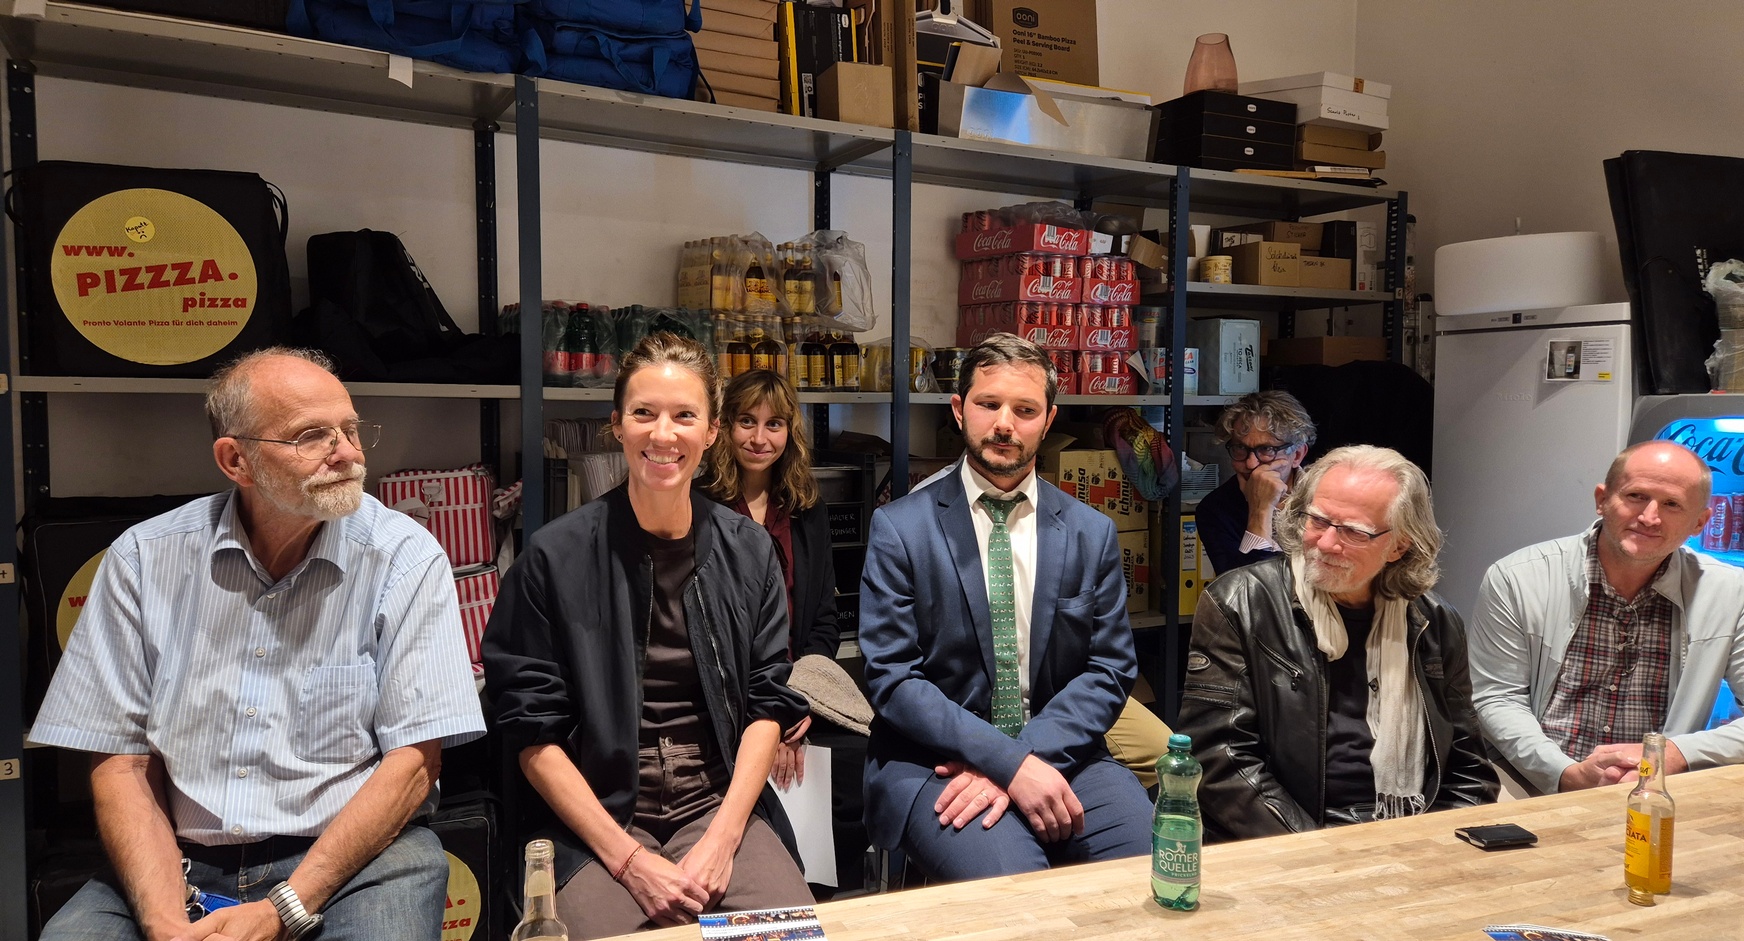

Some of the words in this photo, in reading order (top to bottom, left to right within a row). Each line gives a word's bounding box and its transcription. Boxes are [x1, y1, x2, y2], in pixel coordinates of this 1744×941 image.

[1016, 12, 1035, 22] ooni
[1012, 29, 1026, 37] Ooni
[1037, 33, 1060, 43] Bamboo
[1061, 37, 1077, 45] Pizza
[1031, 41, 1053, 51] Serving
[973, 230, 1014, 252] Coca-Cola
[62, 245, 135, 258] www.
[76, 259, 239, 297] PIZZZA.
[1027, 278, 1073, 299] CoCola
[182, 292, 247, 313] pizza
[83, 319, 111, 327] Pronto
[113, 319, 146, 327] Volante
[149, 319, 170, 327] Pizza
[172, 319, 184, 327] für
[206, 319, 238, 327] daheim
[1087, 329, 1132, 349] CoCola
[1118, 474, 1130, 516] ichnus
[4, 762, 13, 776] 3
[1160, 860, 1198, 872] QUELLE
